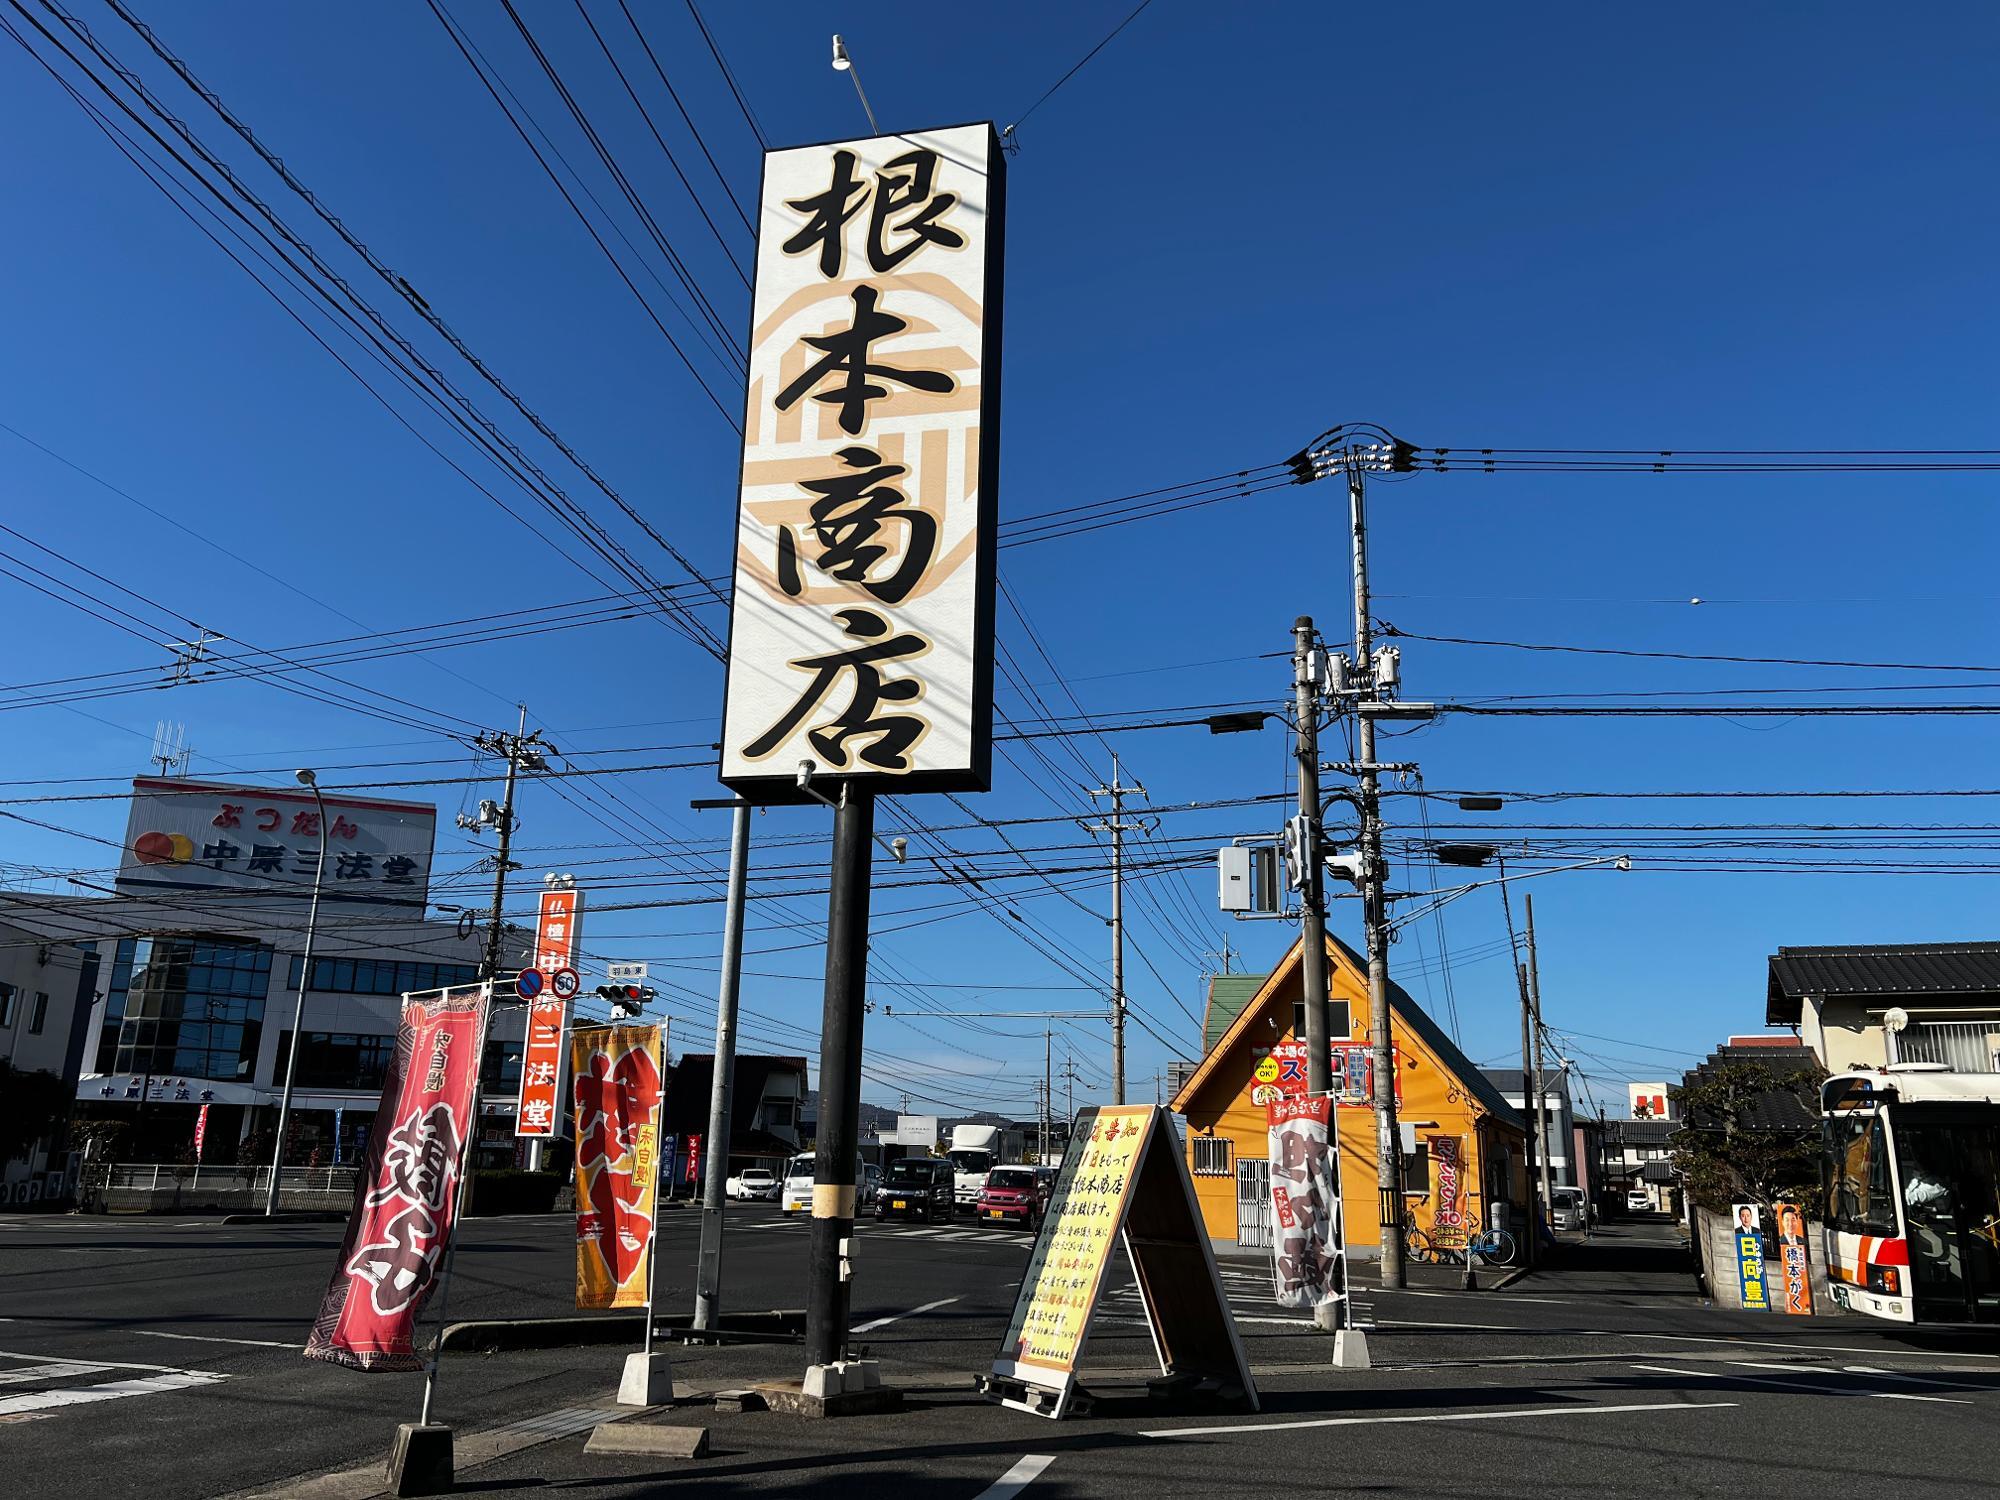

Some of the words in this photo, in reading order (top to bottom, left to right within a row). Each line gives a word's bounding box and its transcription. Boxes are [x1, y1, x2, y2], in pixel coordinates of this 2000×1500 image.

[740, 148, 969, 773] 根本商店
[211, 804, 358, 840] ぶつだん
[203, 839, 418, 885] 中原三法堂
[547, 900, 567, 942] 仏壇
[557, 976, 573, 991] 50
[612, 966, 642, 976] 羽島東
[1273, 1045, 1308, 1058] 本場の
[100, 1086, 215, 1101] 中原三法堂
[130, 1077, 186, 1087] ぶつだん
[1073, 1174, 1125, 1196] 根本商店
[1741, 1236, 1763, 1301] 日向豊
[1786, 1247, 1802, 1310] 橋本がく
